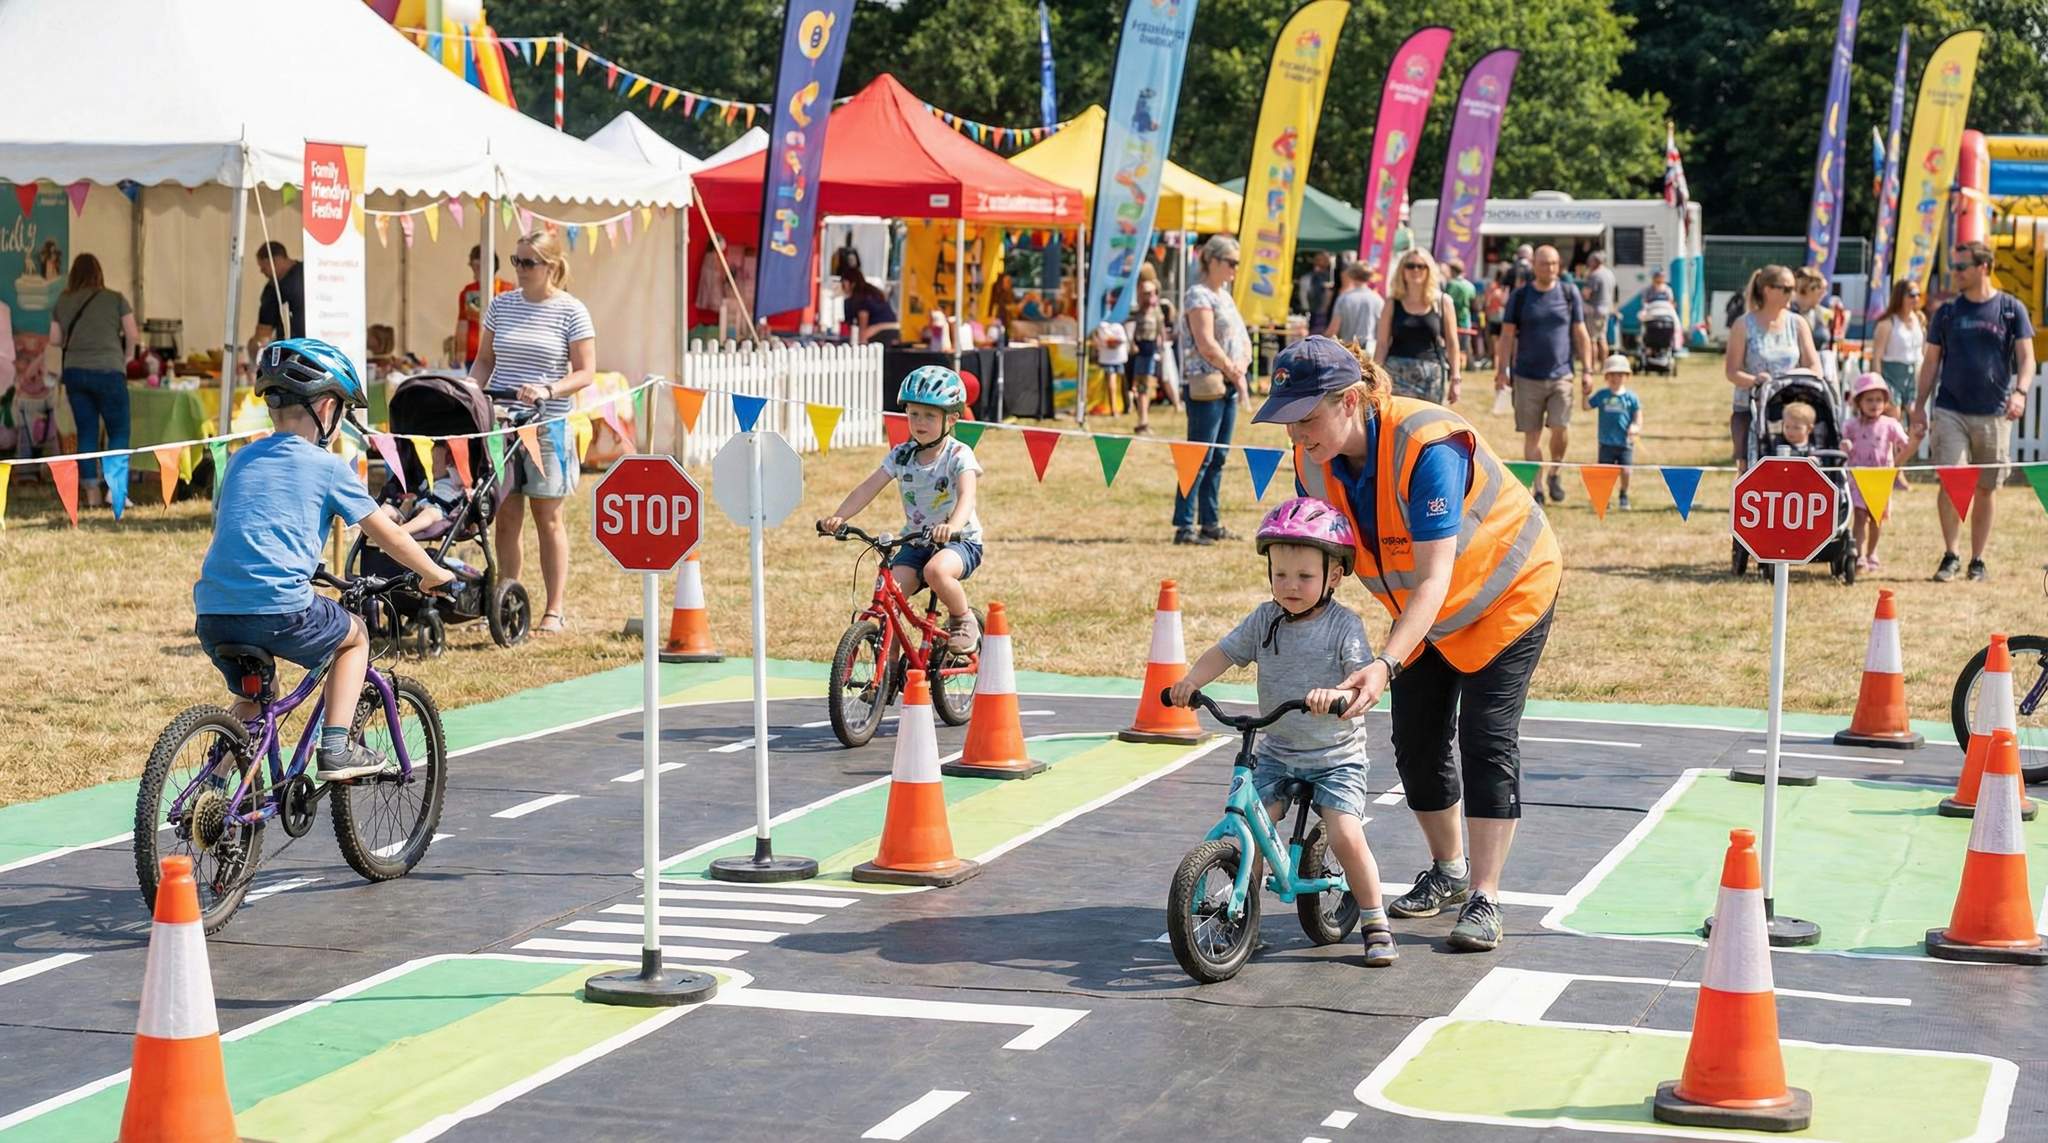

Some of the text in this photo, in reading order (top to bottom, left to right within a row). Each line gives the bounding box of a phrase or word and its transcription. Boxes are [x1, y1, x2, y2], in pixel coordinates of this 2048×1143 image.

[311, 160, 338, 183] Family
[311, 201, 343, 219] Festival
[602, 493, 692, 536] STOP
[1740, 490, 1828, 530] STOP
